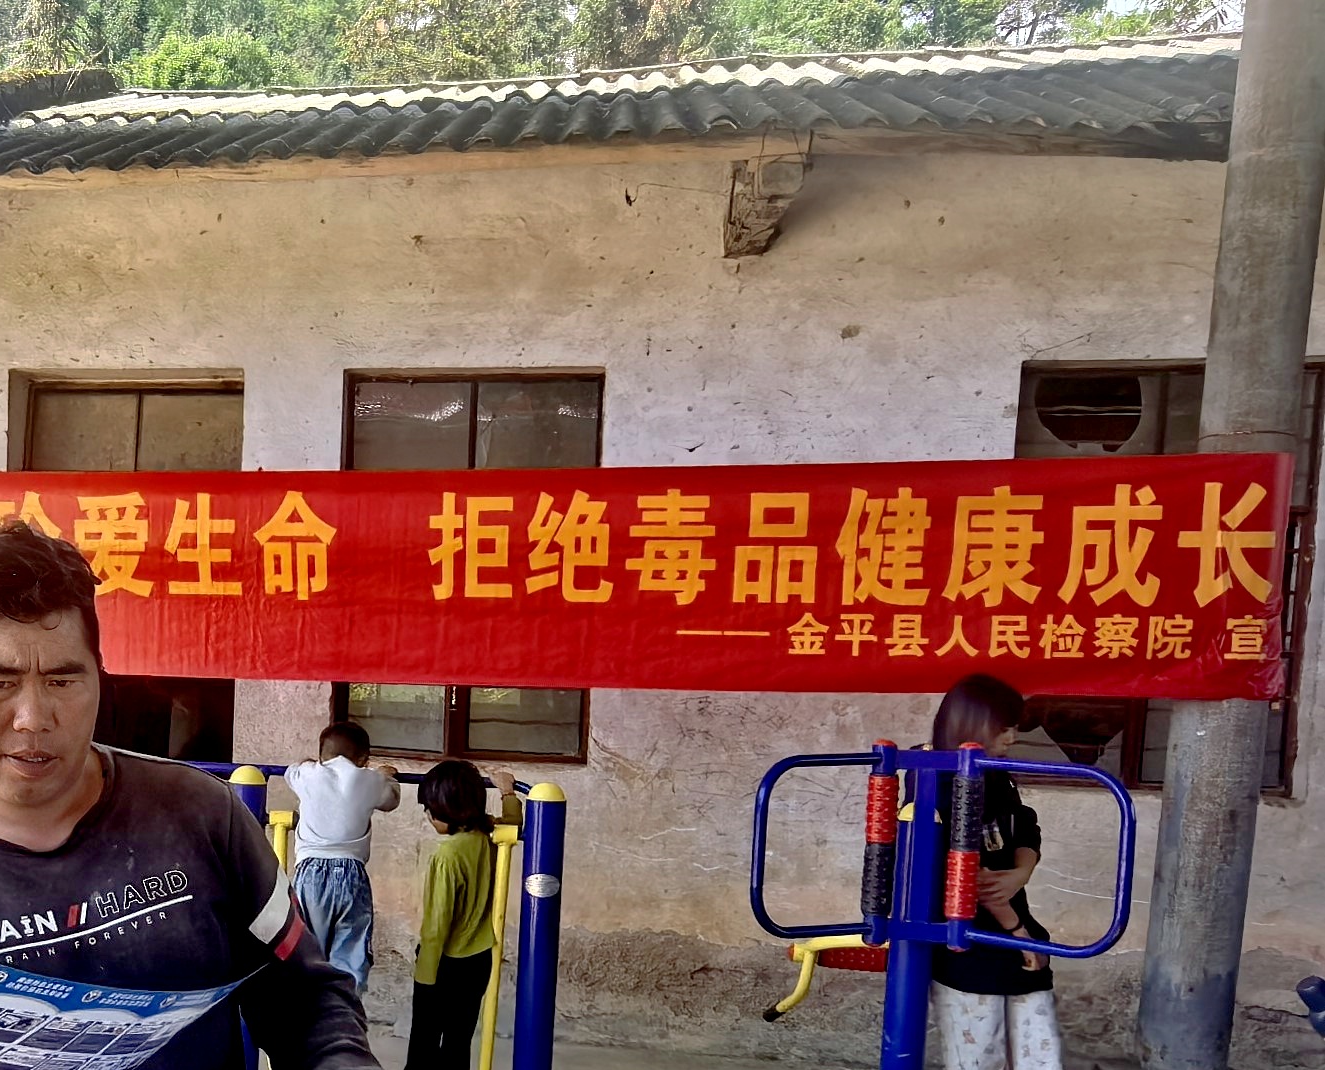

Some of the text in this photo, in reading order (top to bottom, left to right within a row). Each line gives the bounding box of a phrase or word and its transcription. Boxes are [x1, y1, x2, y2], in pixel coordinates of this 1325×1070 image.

[429, 482, 1276, 606] 拒绝毒品健康成长
[1223, 615, 1267, 660] 宣
[95, 870, 188, 918] HARD
[74, 911, 167, 950] FOREVER
